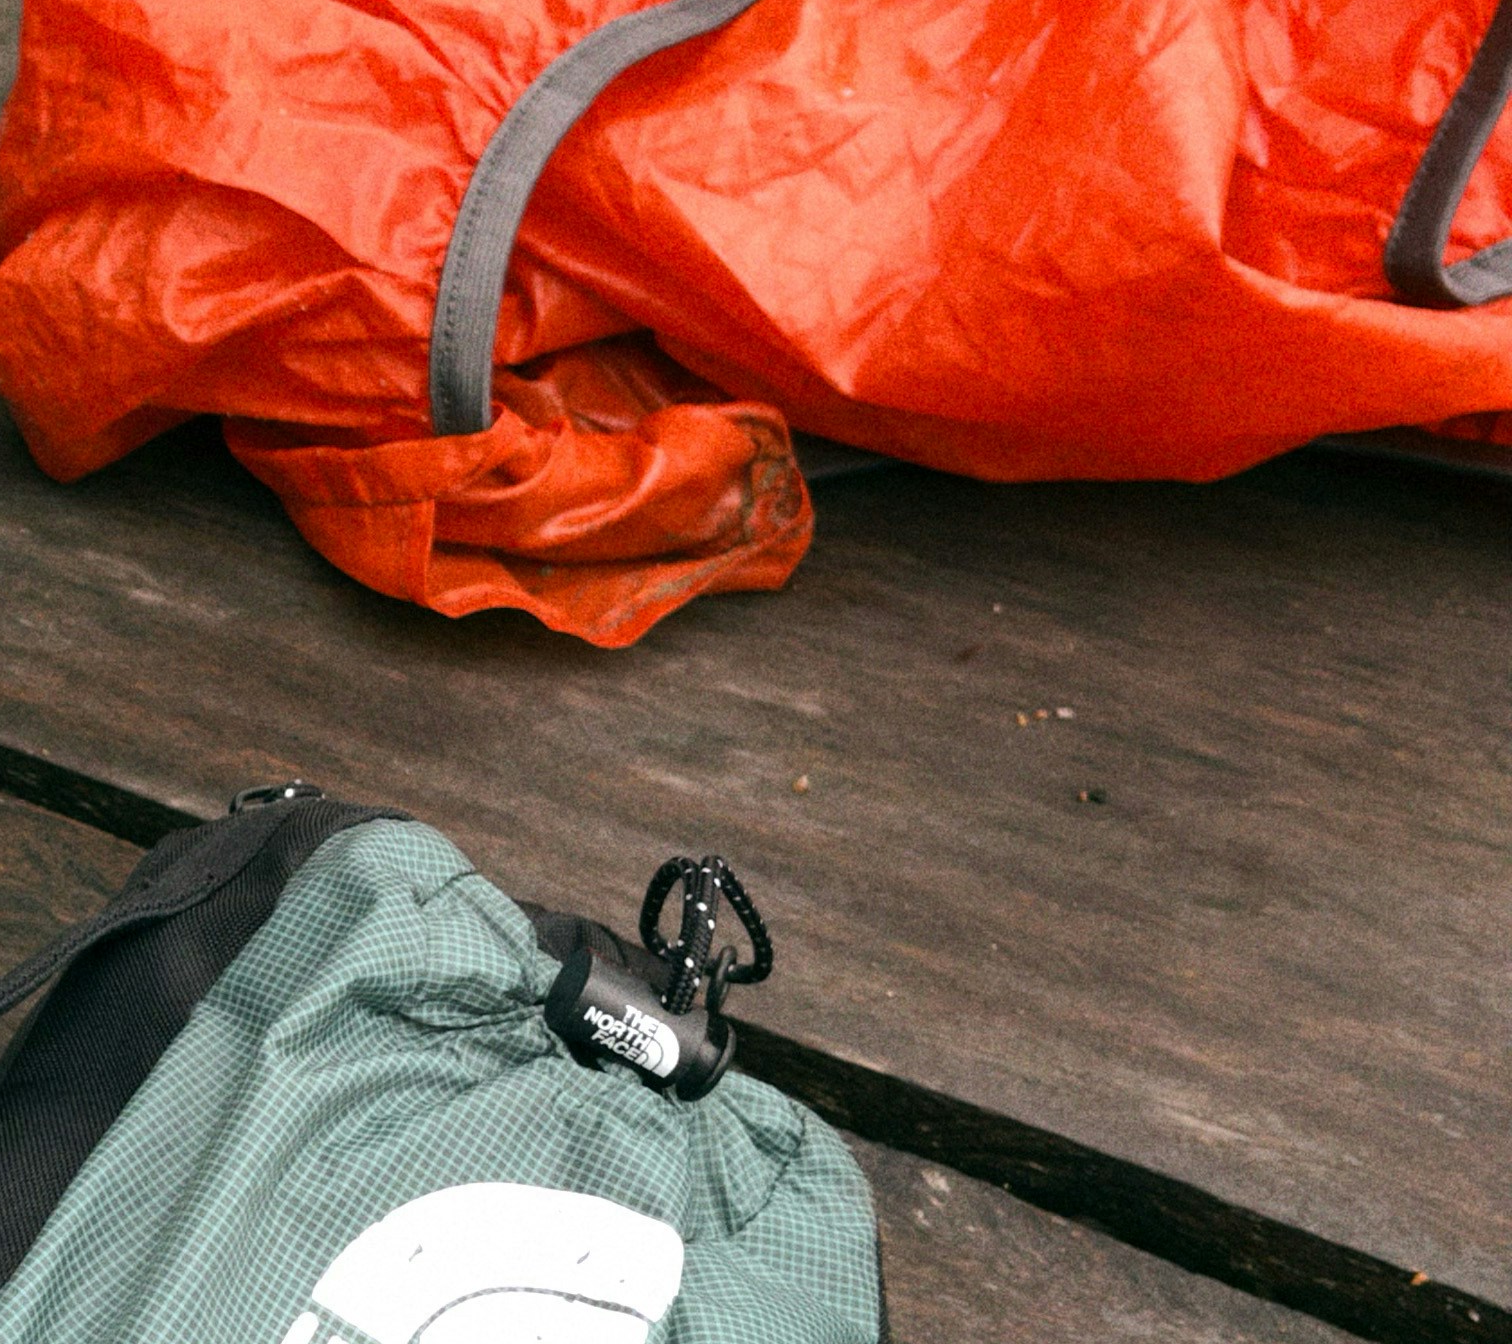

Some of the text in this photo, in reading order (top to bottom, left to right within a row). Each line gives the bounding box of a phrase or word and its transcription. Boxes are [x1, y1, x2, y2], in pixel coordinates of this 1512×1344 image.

[583, 1006, 652, 1051] NORTH
[623, 1004, 660, 1037] THE
[591, 1029, 642, 1061] FACE
